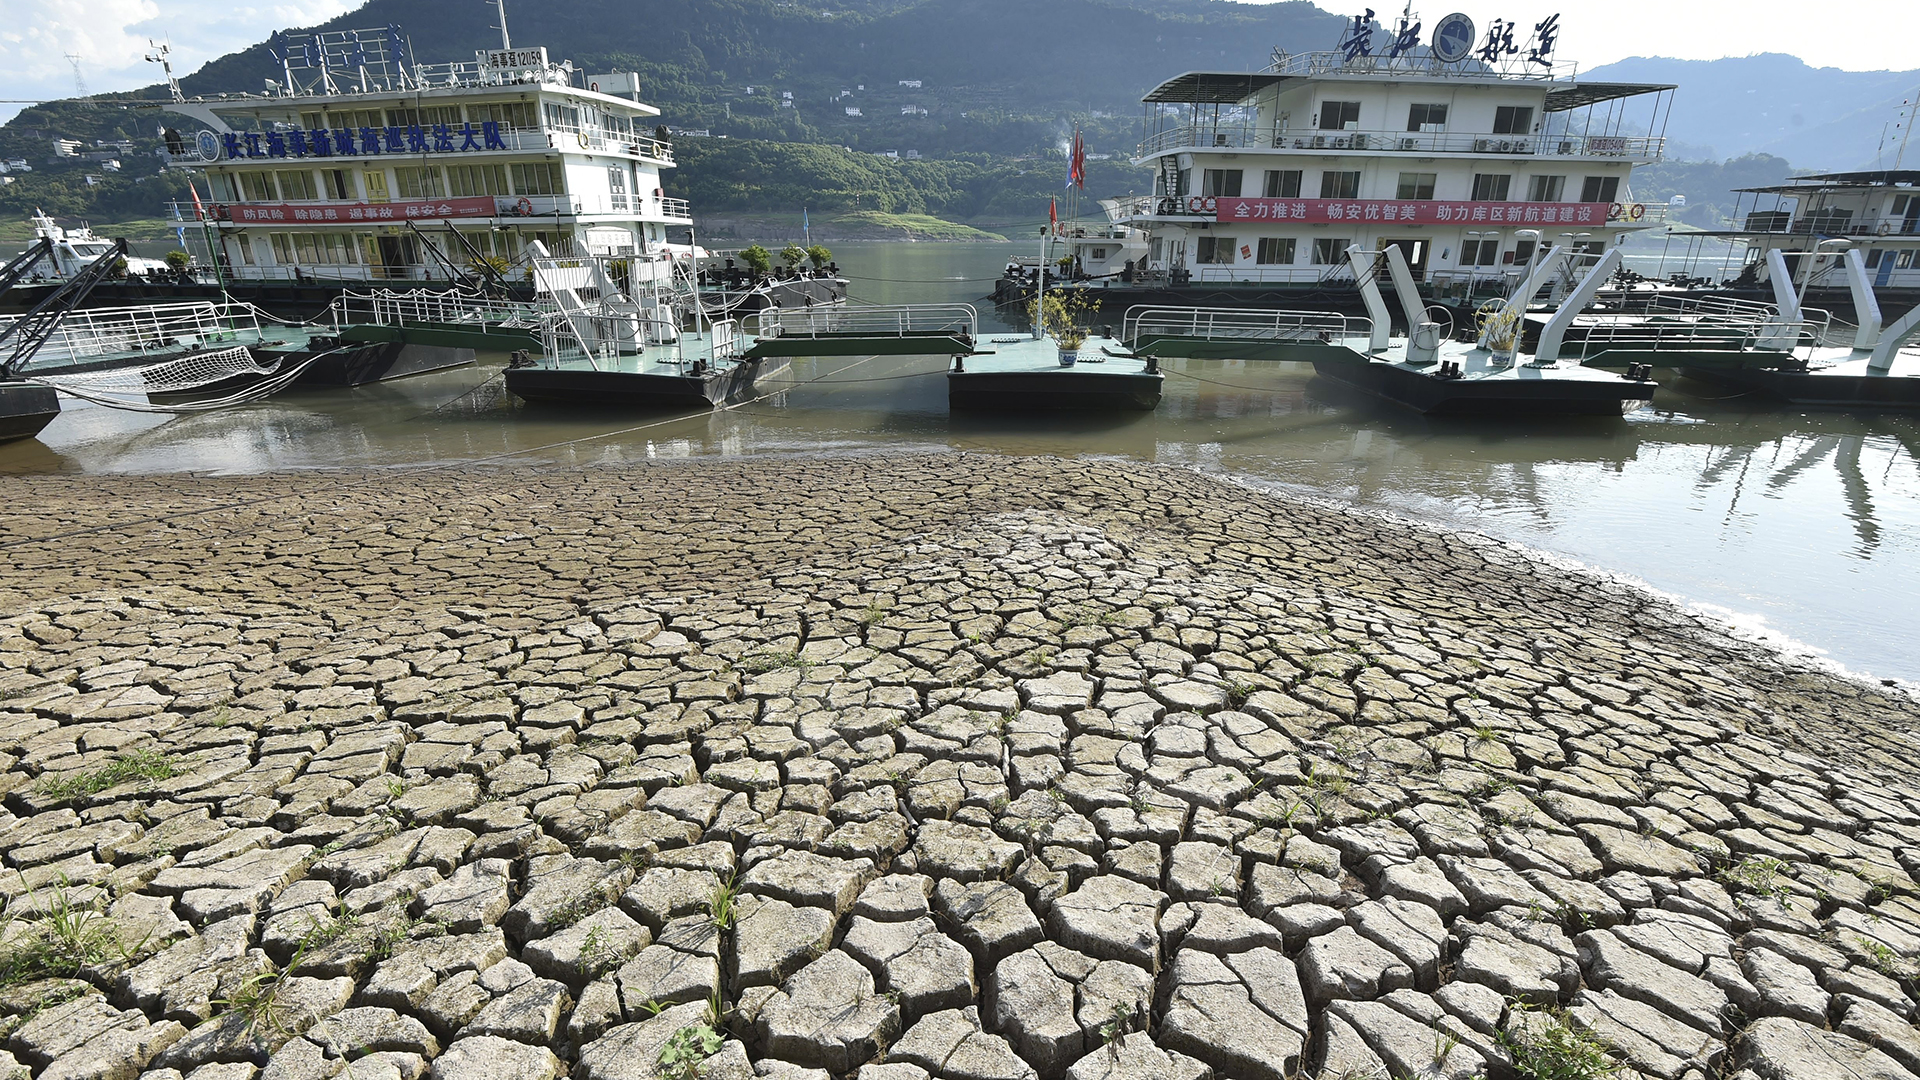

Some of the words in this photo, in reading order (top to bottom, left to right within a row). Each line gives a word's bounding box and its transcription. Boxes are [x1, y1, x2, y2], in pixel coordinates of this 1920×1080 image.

[490, 51, 542, 69] 海事趸12059
[223, 121, 507, 160] 长江海事新城海巡执法大队
[243, 208, 285, 220] 防风险
[294, 208, 338, 220] 除隐患
[349, 207, 394, 220] 遏事故
[405, 203, 453, 217] 保安全
[1234, 201, 1307, 219] 全力推进
[1436, 205, 1593, 223] 助力库区新航道建设
